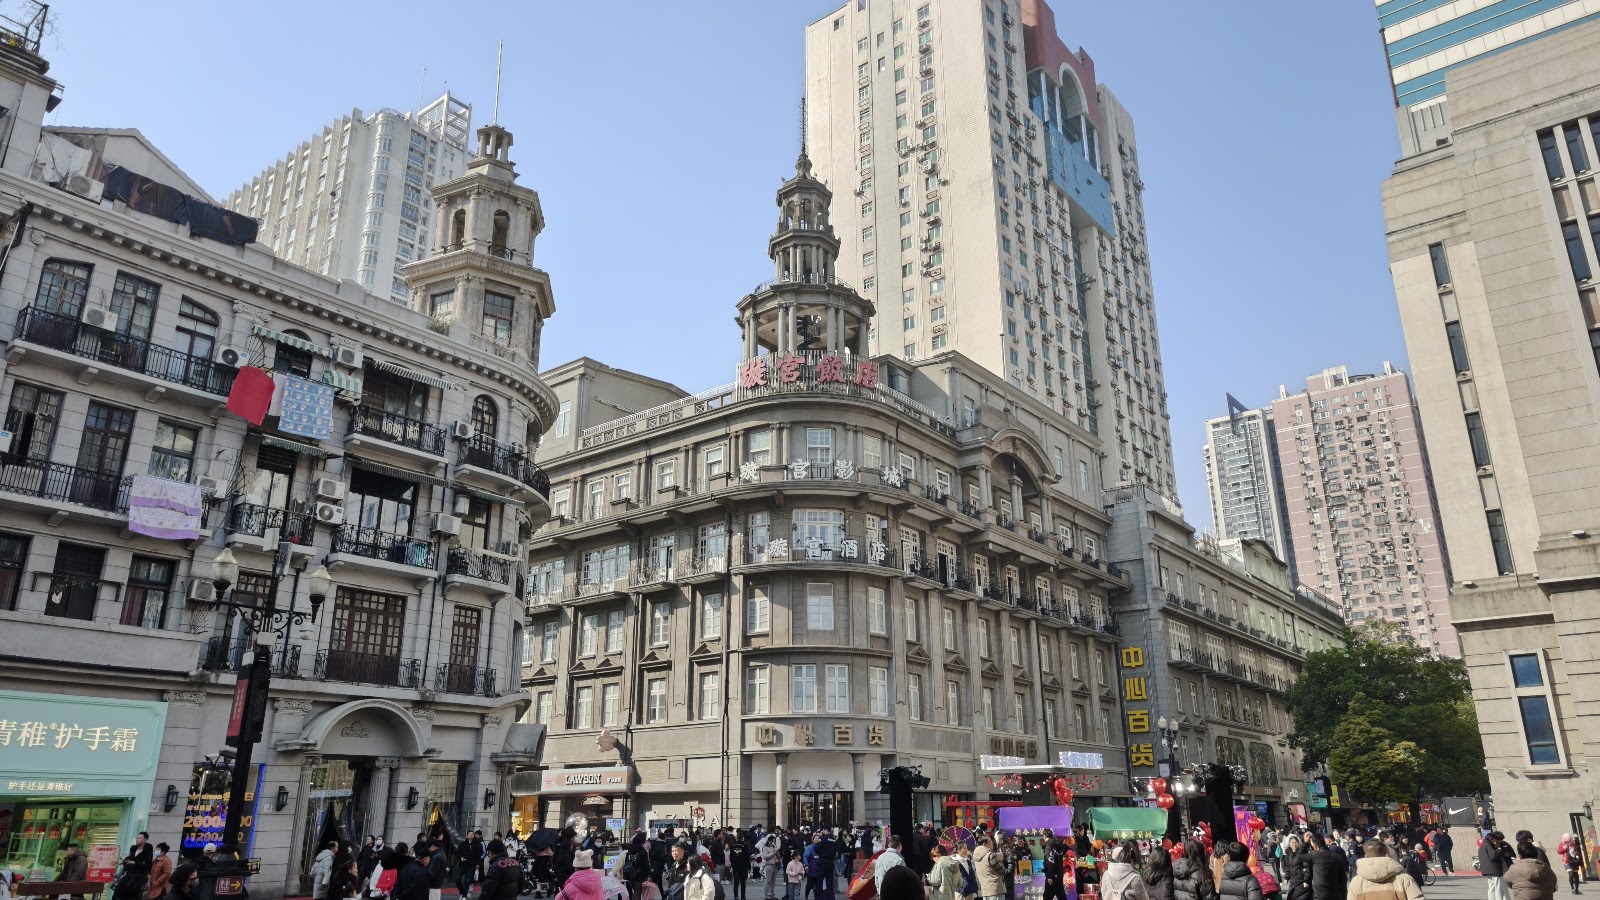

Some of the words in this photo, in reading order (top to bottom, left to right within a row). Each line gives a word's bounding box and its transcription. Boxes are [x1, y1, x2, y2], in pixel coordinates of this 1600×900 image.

[1122, 647, 1154, 766] 中心百货
[565, 774, 601, 785] LAWSON
[790, 779, 845, 790] ZARA
[8, 781, 73, 792] 护手还是青稚好
